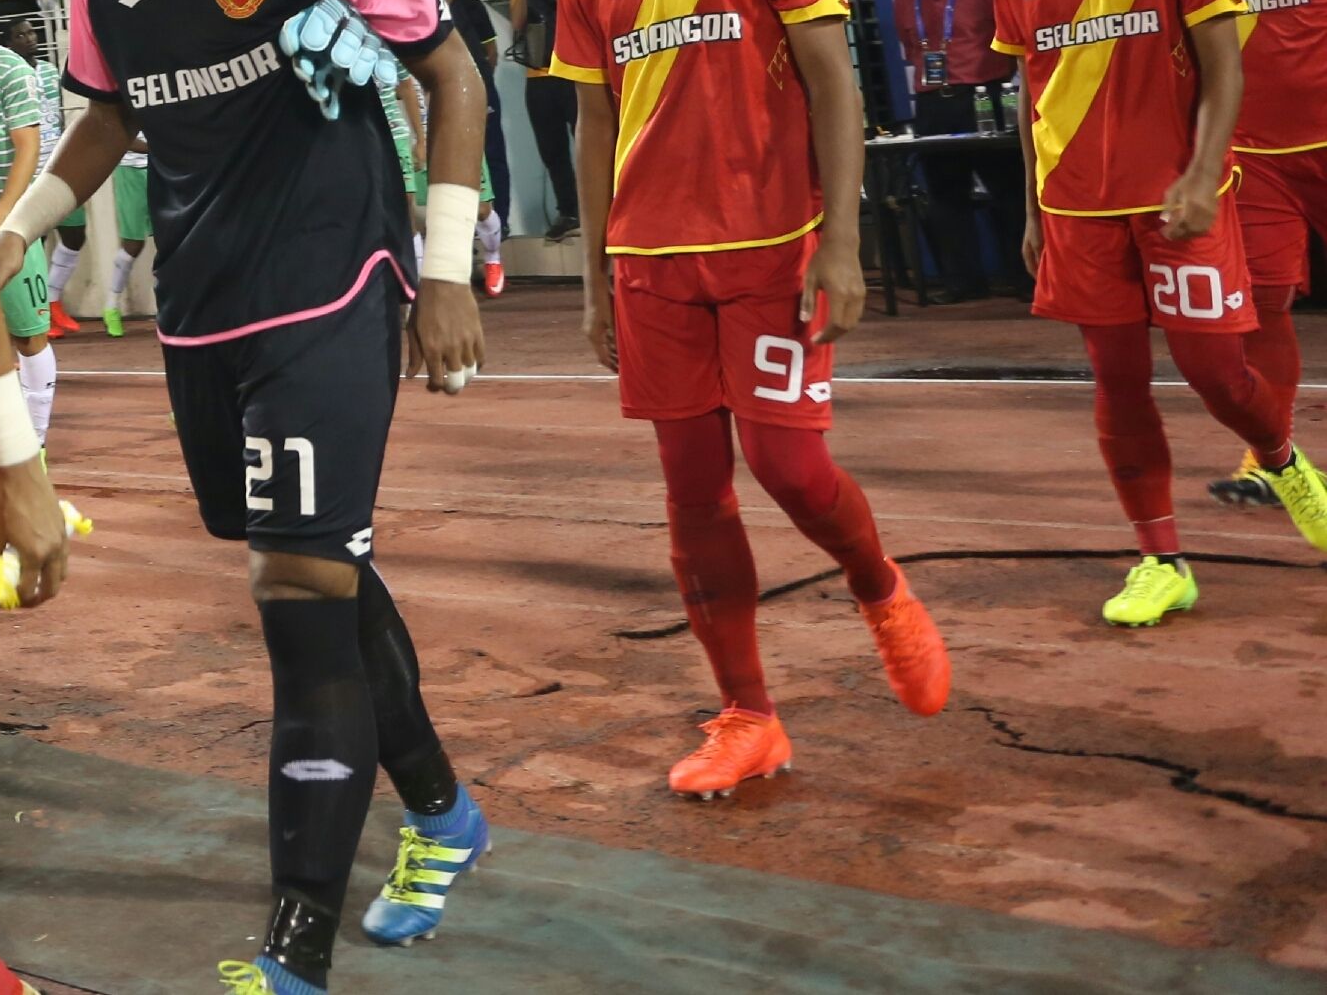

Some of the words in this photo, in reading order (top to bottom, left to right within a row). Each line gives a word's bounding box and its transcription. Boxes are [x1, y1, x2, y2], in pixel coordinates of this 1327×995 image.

[612, 12, 742, 65] SELANGOR
[1035, 10, 1160, 52] SELANGOR
[127, 41, 281, 109] SELANGOR
[23, 274, 48, 308] 10
[1149, 263, 1223, 319] 20
[753, 335, 804, 403] 9
[245, 436, 316, 515] 21
